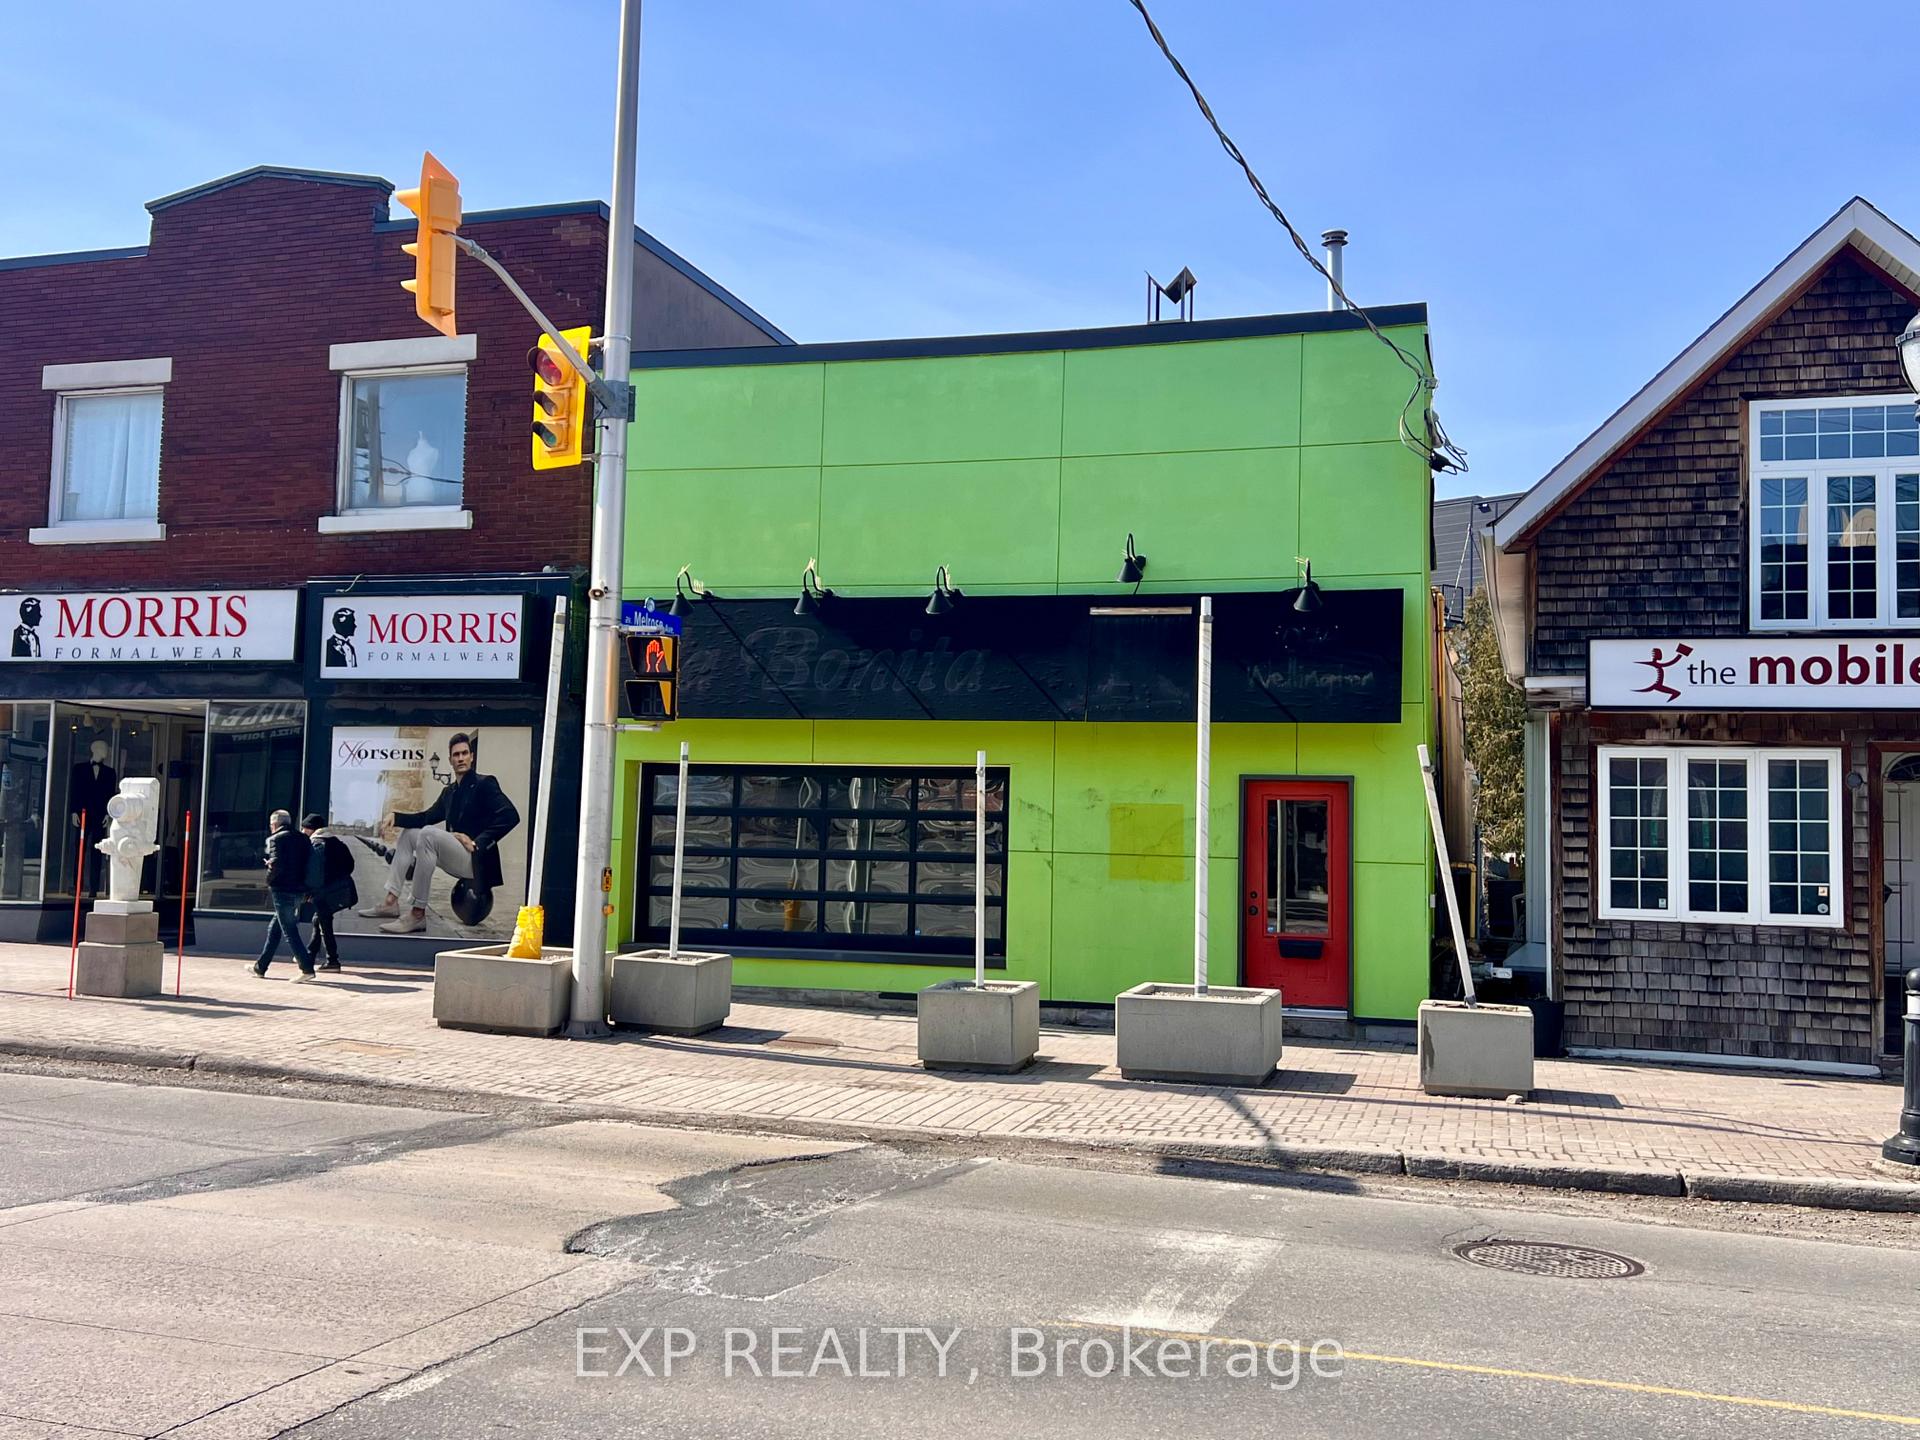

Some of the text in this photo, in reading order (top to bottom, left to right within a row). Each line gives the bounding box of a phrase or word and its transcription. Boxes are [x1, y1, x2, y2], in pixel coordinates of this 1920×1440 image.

[55, 595, 248, 639] MORRIS
[367, 611, 517, 644] MORRIS
[633, 610, 664, 630] Melrose
[54, 646, 243, 660] FORMAL WEAR
[367, 651, 515, 662] FORMAL WEAR
[1687, 659, 1736, 685] the
